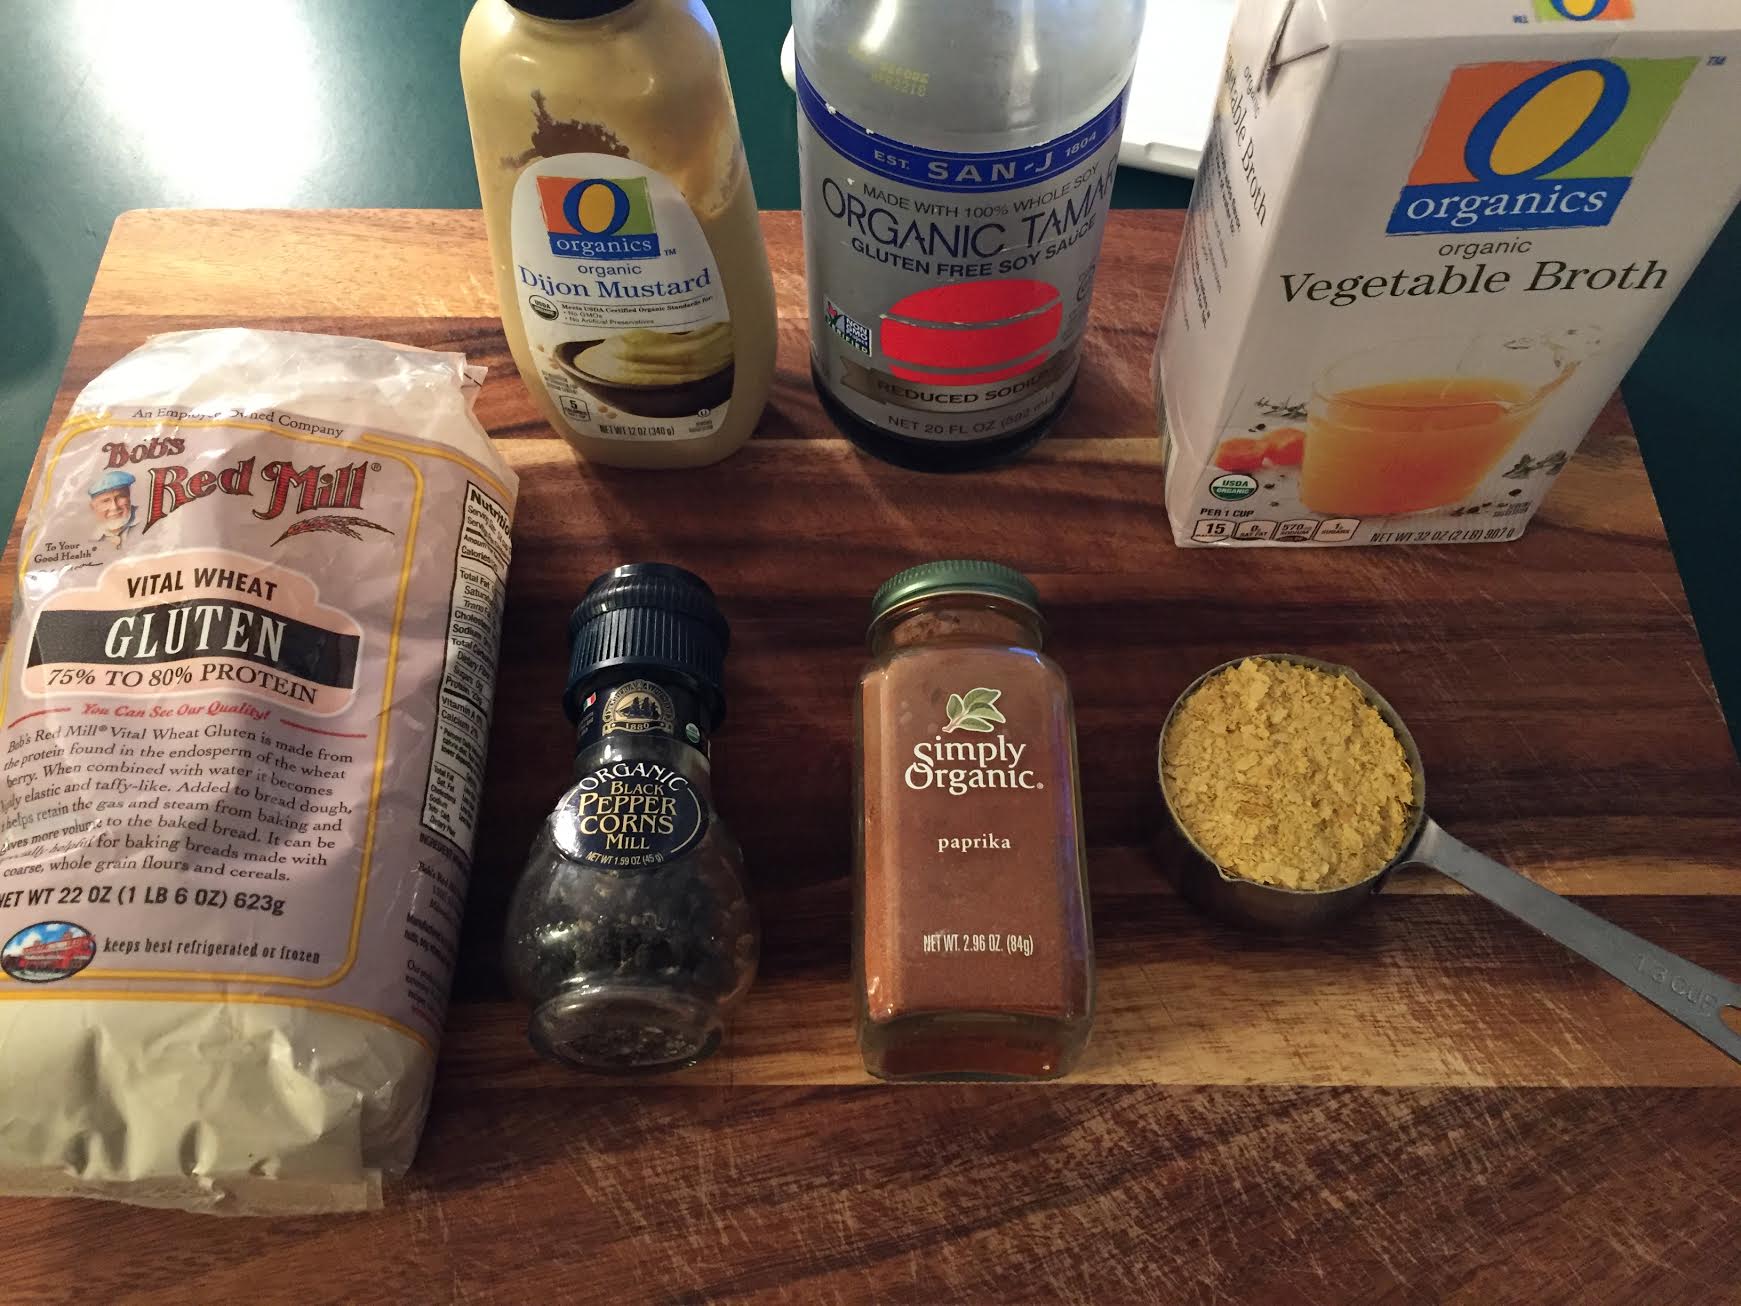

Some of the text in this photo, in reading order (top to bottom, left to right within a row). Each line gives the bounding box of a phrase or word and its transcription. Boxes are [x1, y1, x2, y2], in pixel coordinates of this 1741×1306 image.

[1463, 58, 1631, 181] O
[873, 131, 1097, 183] EST. SAN-J 1804
[863, 160, 1100, 219] MADE WITH 100% WHOLE SOY
[1241, 136, 1267, 228] Broth
[562, 177, 630, 236] O
[822, 177, 1007, 259] ORGANIC
[1406, 184, 1608, 228] organics
[556, 237, 676, 256] organics TM
[851, 236, 930, 273] GLUTEN
[936, 263, 993, 278] FREE
[999, 251, 1042, 274] SOY
[1438, 236, 1533, 260] organic
[518, 264, 711, 299] Dijon Mustard
[577, 263, 642, 278] organic
[1280, 260, 1669, 308] Vegetable Broth
[561, 303, 583, 312] Meets
[605, 306, 637, 314] Certified
[638, 305, 666, 313] Organic
[666, 300, 701, 311] Standards
[846, 317, 867, 335] NON
[846, 323, 867, 341] GMO
[570, 399, 578, 410] 5
[877, 380, 979, 404] REDUCED
[132, 408, 344, 438] An Company
[600, 424, 666, 437] NET WT 12 OZ (340
[888, 414, 996, 435] NET 20 FL OZ
[102, 436, 185, 470] Bob's
[142, 456, 369, 534] Red Mill
[1216, 487, 1250, 495] ORGANIC
[1221, 478, 1249, 488] USDA
[1200, 508, 1255, 518] PER CUP
[1206, 522, 1226, 534] 15
[1282, 523, 1304, 531] 570
[59, 541, 80, 551] Your
[1370, 528, 1505, 543] NET WT 32 OZ LB) 907
[34, 550, 92, 564] Good Health
[127, 567, 278, 601] VITAL WHEAT
[104, 605, 288, 662] GLUTEN
[47, 663, 319, 705] 75% TO 80% PROTEIN
[82, 700, 272, 720] You Can See Our Quality!
[625, 722, 650, 731] 1880
[8, 733, 31, 754] Bob's
[35, 729, 60, 743] Red
[111, 726, 147, 740] Vital
[153, 727, 200, 741] Wheat
[204, 724, 256, 741] Gluten
[261, 731, 272, 746] is
[275, 740, 314, 758] made
[318, 749, 353, 764] from
[913, 735, 1026, 769] Simply
[4, 742, 346, 780] the protein found in the endosperm of the wheat
[7, 761, 333, 796] berry. When combined with water it becomes
[578, 762, 689, 792] ORGANIC
[905, 761, 1036, 796] Organic
[24, 778, 353, 816] elastic and taffy-like. Added to bread dough,
[6, 812, 34, 830] helps
[36, 802, 70, 822] retain
[72, 796, 93, 812] the
[96, 800, 124, 812] gas
[128, 796, 160, 809] and
[163, 800, 209, 811] steam
[214, 799, 252, 819] from
[258, 807, 308, 833] baking
[312, 818, 343, 832] and
[580, 814, 674, 835] CORNS
[31, 814, 336, 849] more to the baked bread. It can be
[938, 833, 1012, 853] paprika
[96, 832, 328, 867] for baking breads made with
[585, 851, 655, 866] NET WT 1.59 OZ (45
[3, 855, 291, 881] coarse, whole grain flours and cereals.
[28, 885, 286, 916] WT 22 OZ (1 LB 6 OZ) 623g
[103, 937, 320, 965] keeps best refrigerated or frozen
[923, 933, 1034, 957] NET WT. 2.96 OZ. (84g)
